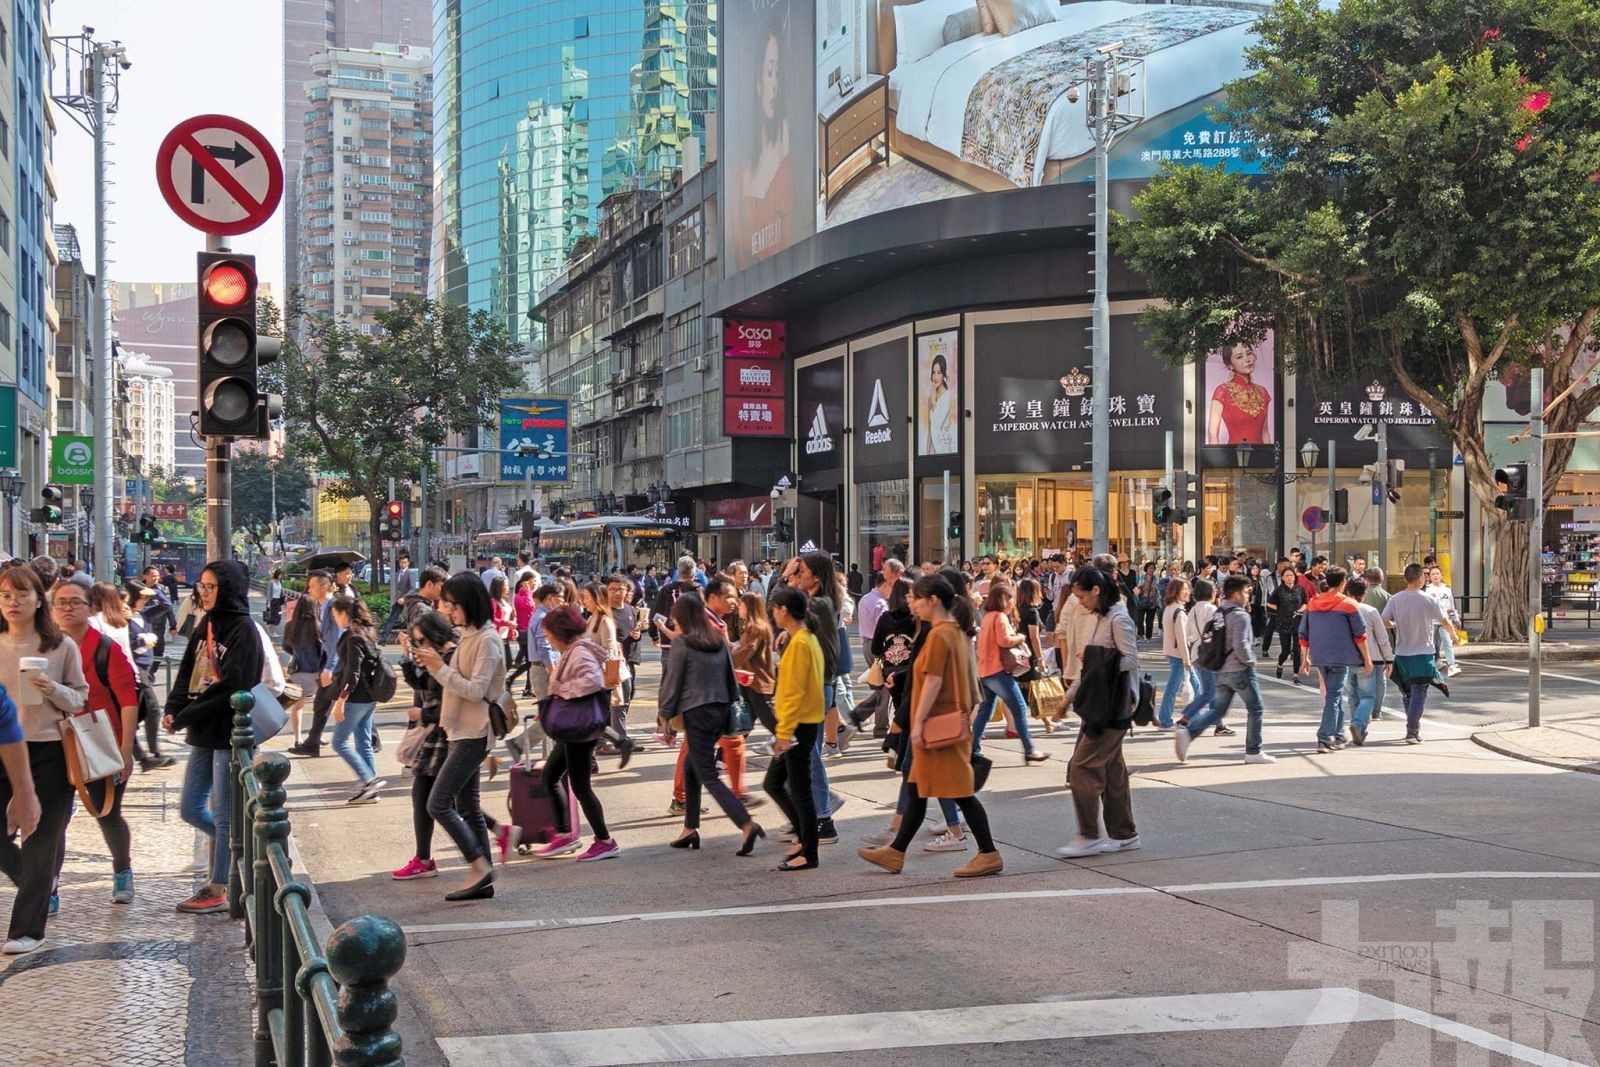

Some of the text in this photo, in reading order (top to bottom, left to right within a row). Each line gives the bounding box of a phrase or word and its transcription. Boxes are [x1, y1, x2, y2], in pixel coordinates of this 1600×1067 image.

[993, 416, 1162, 432] EMPEROR WATCH AN EWELLERY
[1394, 417, 1437, 425] JEWELLERY
[865, 427, 893, 445] Reebok
[806, 436, 833, 454] adidas
